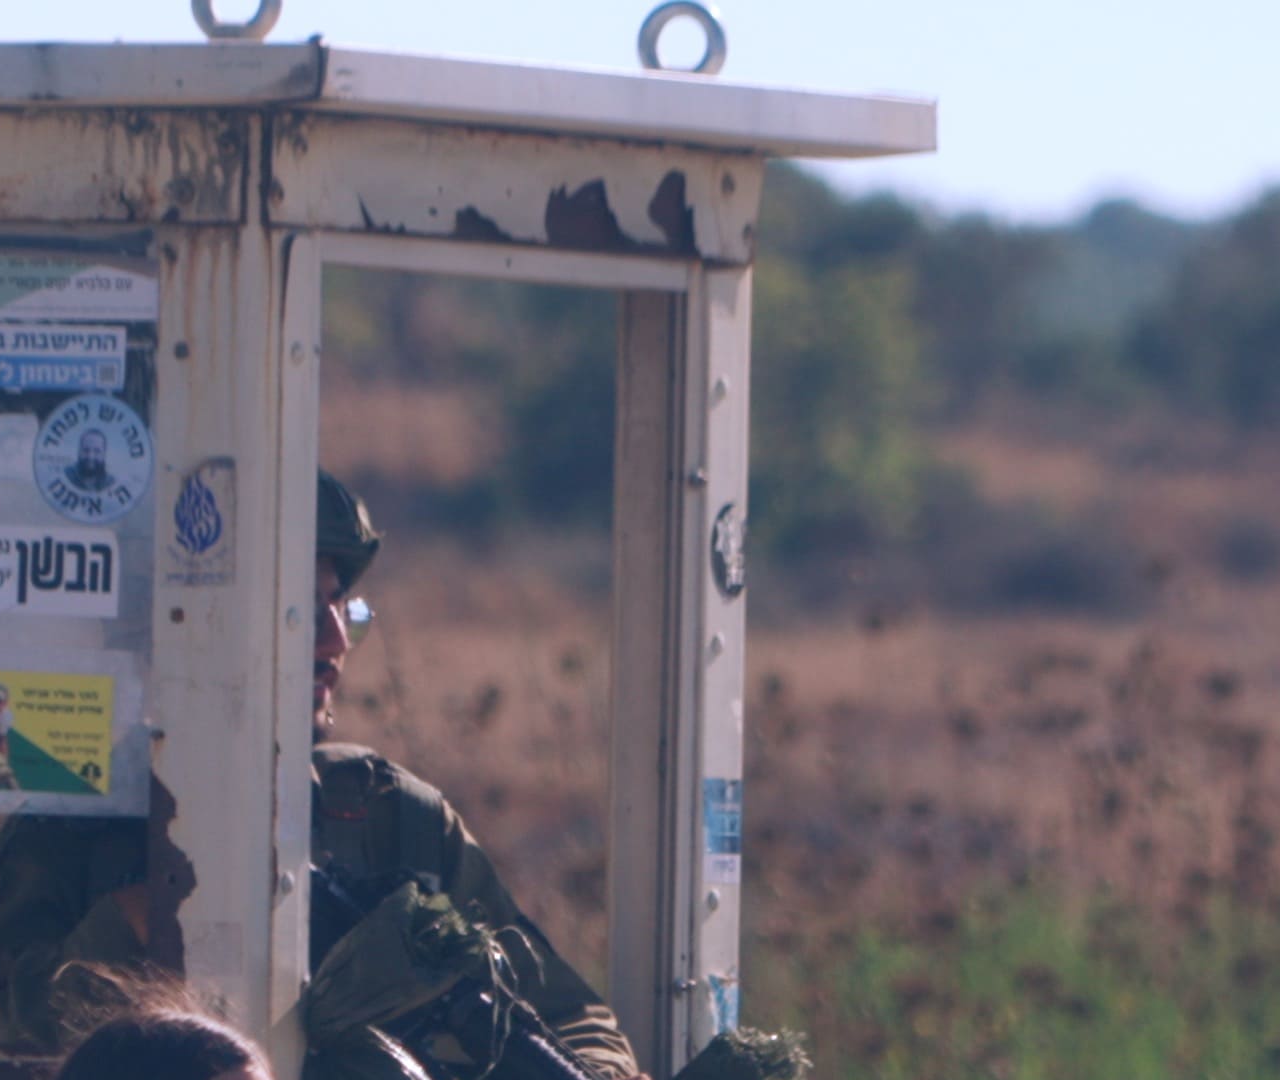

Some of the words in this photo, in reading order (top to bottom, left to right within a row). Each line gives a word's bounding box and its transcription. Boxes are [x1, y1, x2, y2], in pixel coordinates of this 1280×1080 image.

[12, 331, 118, 352] התיישבות
[21, 361, 92, 385] ביטחון
[42, 400, 91, 450] לפחד
[96, 402, 124, 423] יש
[122, 420, 147, 461] מה
[46, 480, 104, 517] איתנו
[14, 535, 114, 605] הבשן
